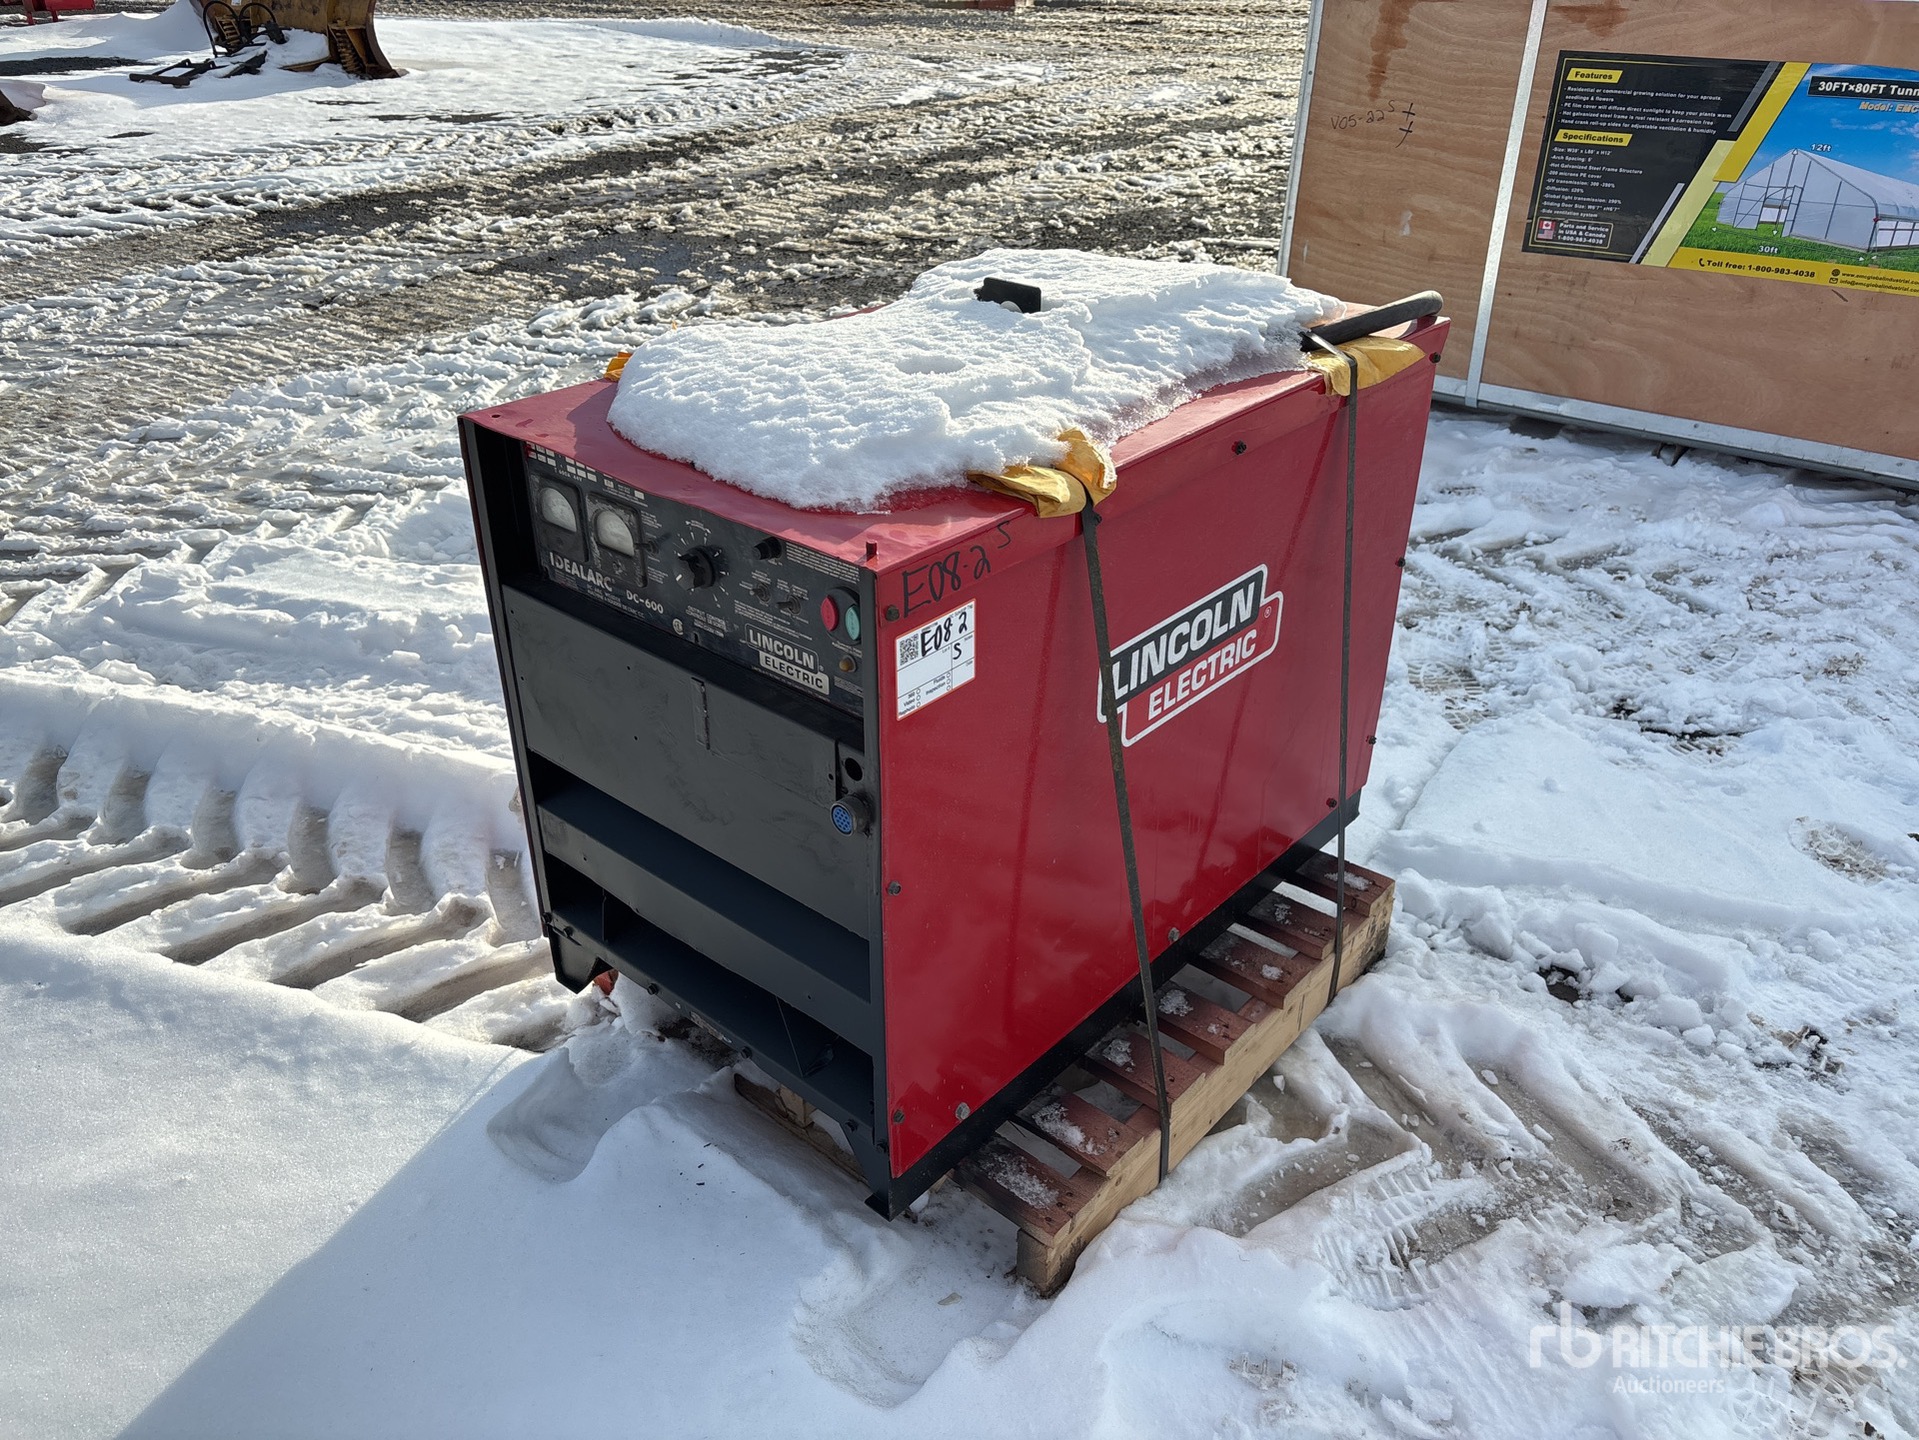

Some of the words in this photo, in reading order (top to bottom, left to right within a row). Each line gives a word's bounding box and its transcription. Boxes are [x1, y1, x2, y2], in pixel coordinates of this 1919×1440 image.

[1575, 71, 1612, 80] Features
[1859, 102, 1893, 111] Model:
[1562, 132, 1624, 143] Specifications
[1558, 235, 1603, 244] 1-800-983-4038
[1758, 246, 1778, 254] 30ft
[1725, 262, 1745, 270] free:
[1748, 265, 1815, 278] 1-800-983-4038
[550, 552, 613, 592] IDEALARC
[626, 590, 664, 614] DC-600
[749, 629, 814, 670] LINCOLN
[1112, 582, 1255, 700] LINCOLN
[765, 655, 823, 689] ELECTRIC
[1148, 629, 1257, 721] ELECTRIC
